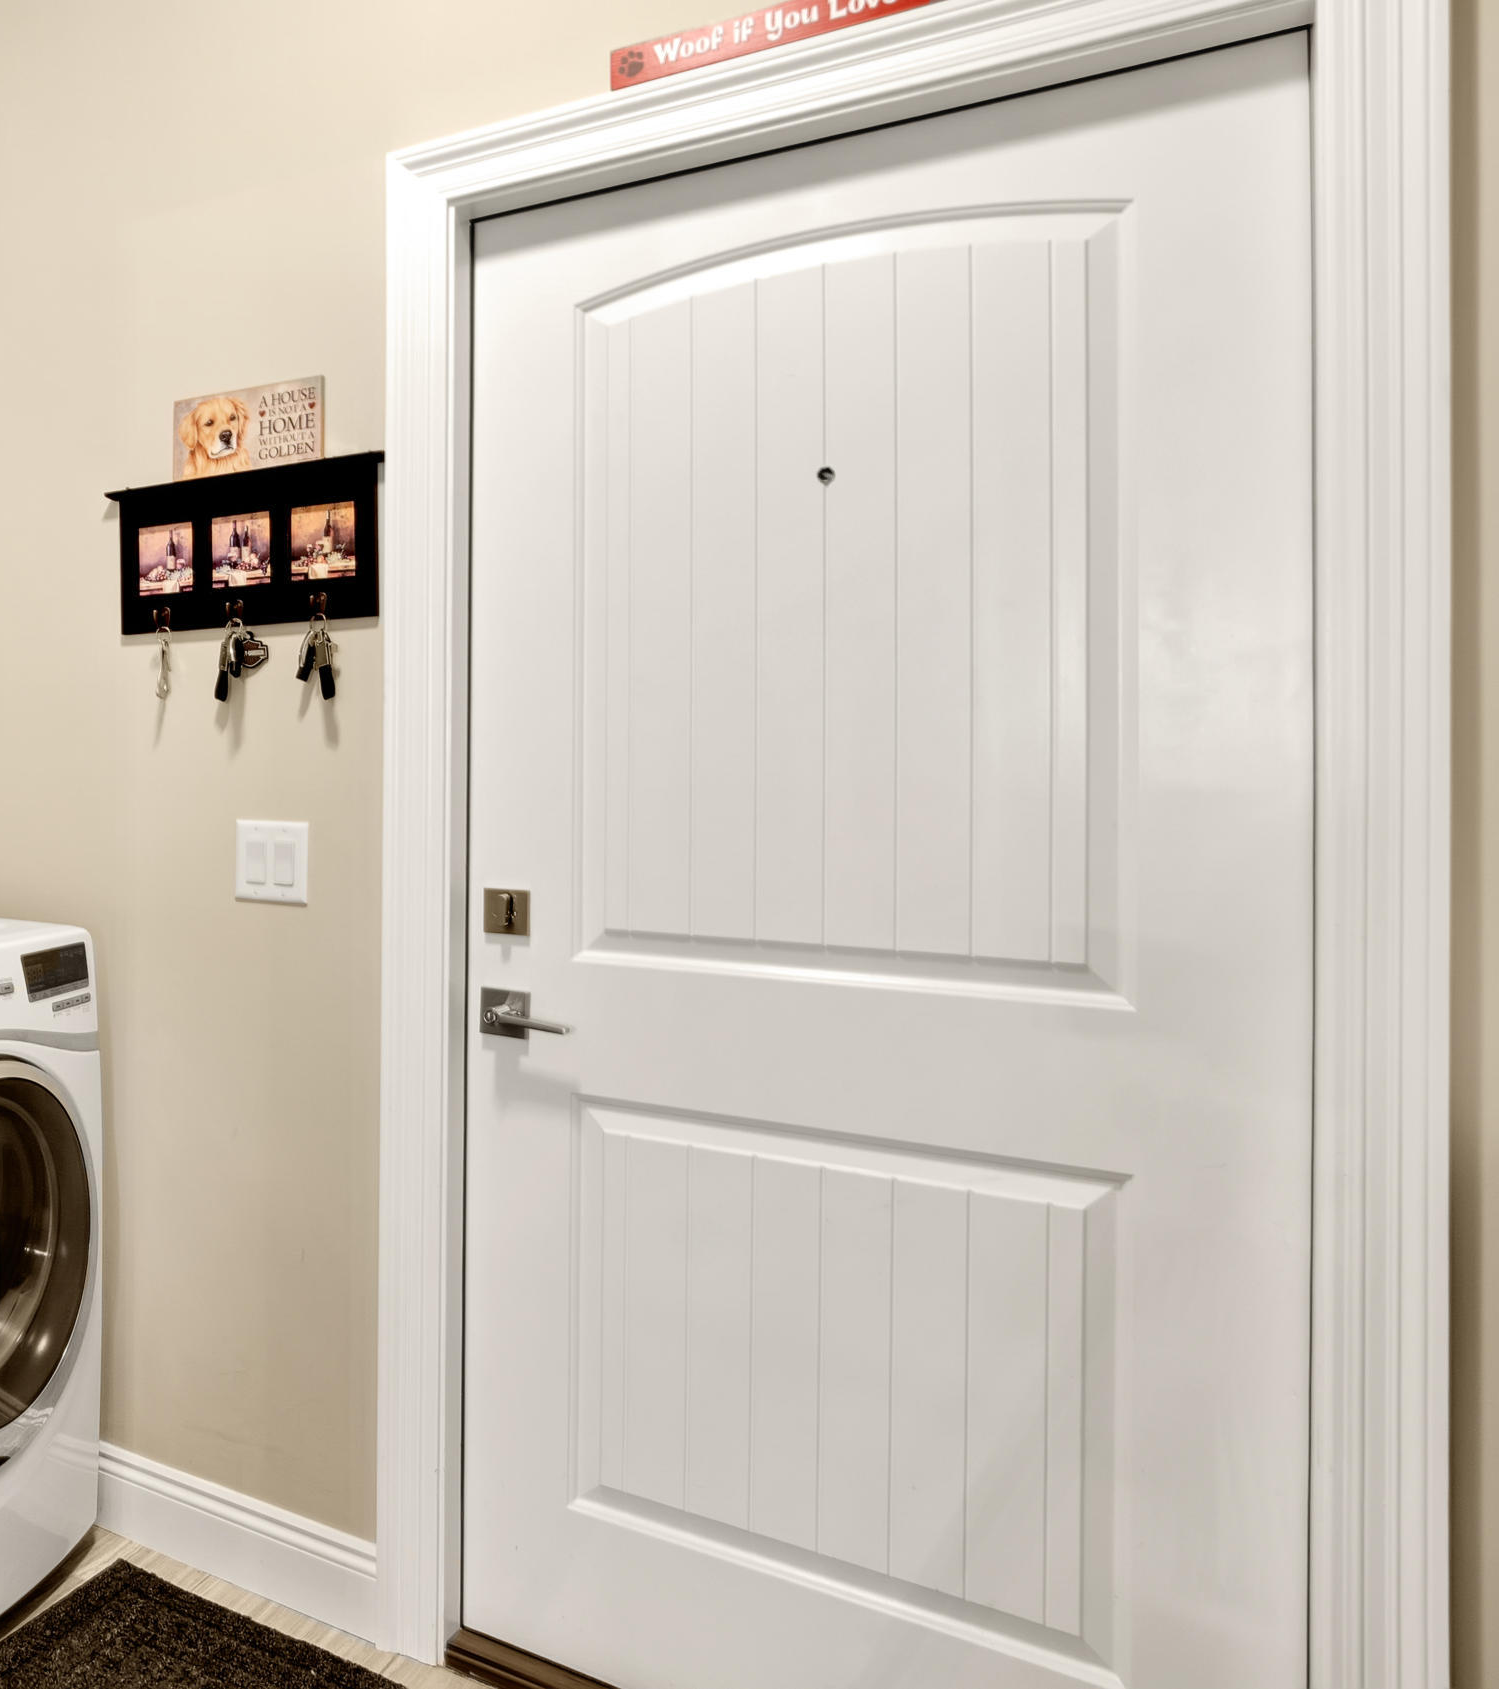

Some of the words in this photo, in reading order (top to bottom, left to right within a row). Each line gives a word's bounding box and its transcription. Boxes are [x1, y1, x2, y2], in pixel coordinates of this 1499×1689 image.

[653, 26, 723, 64] Woof
[733, 20, 753, 44] if
[764, 5, 818, 40] You
[259, 395, 268, 409] A
[271, 387, 315, 406] HOUSE
[269, 409, 276, 417] IS
[278, 404, 297, 416] NOT
[299, 403, 307, 412] A
[259, 412, 315, 436] HOME
[259, 431, 305, 446] WITHOUT
[308, 430, 315, 440] A
[258, 441, 315, 460] GOLDEN
